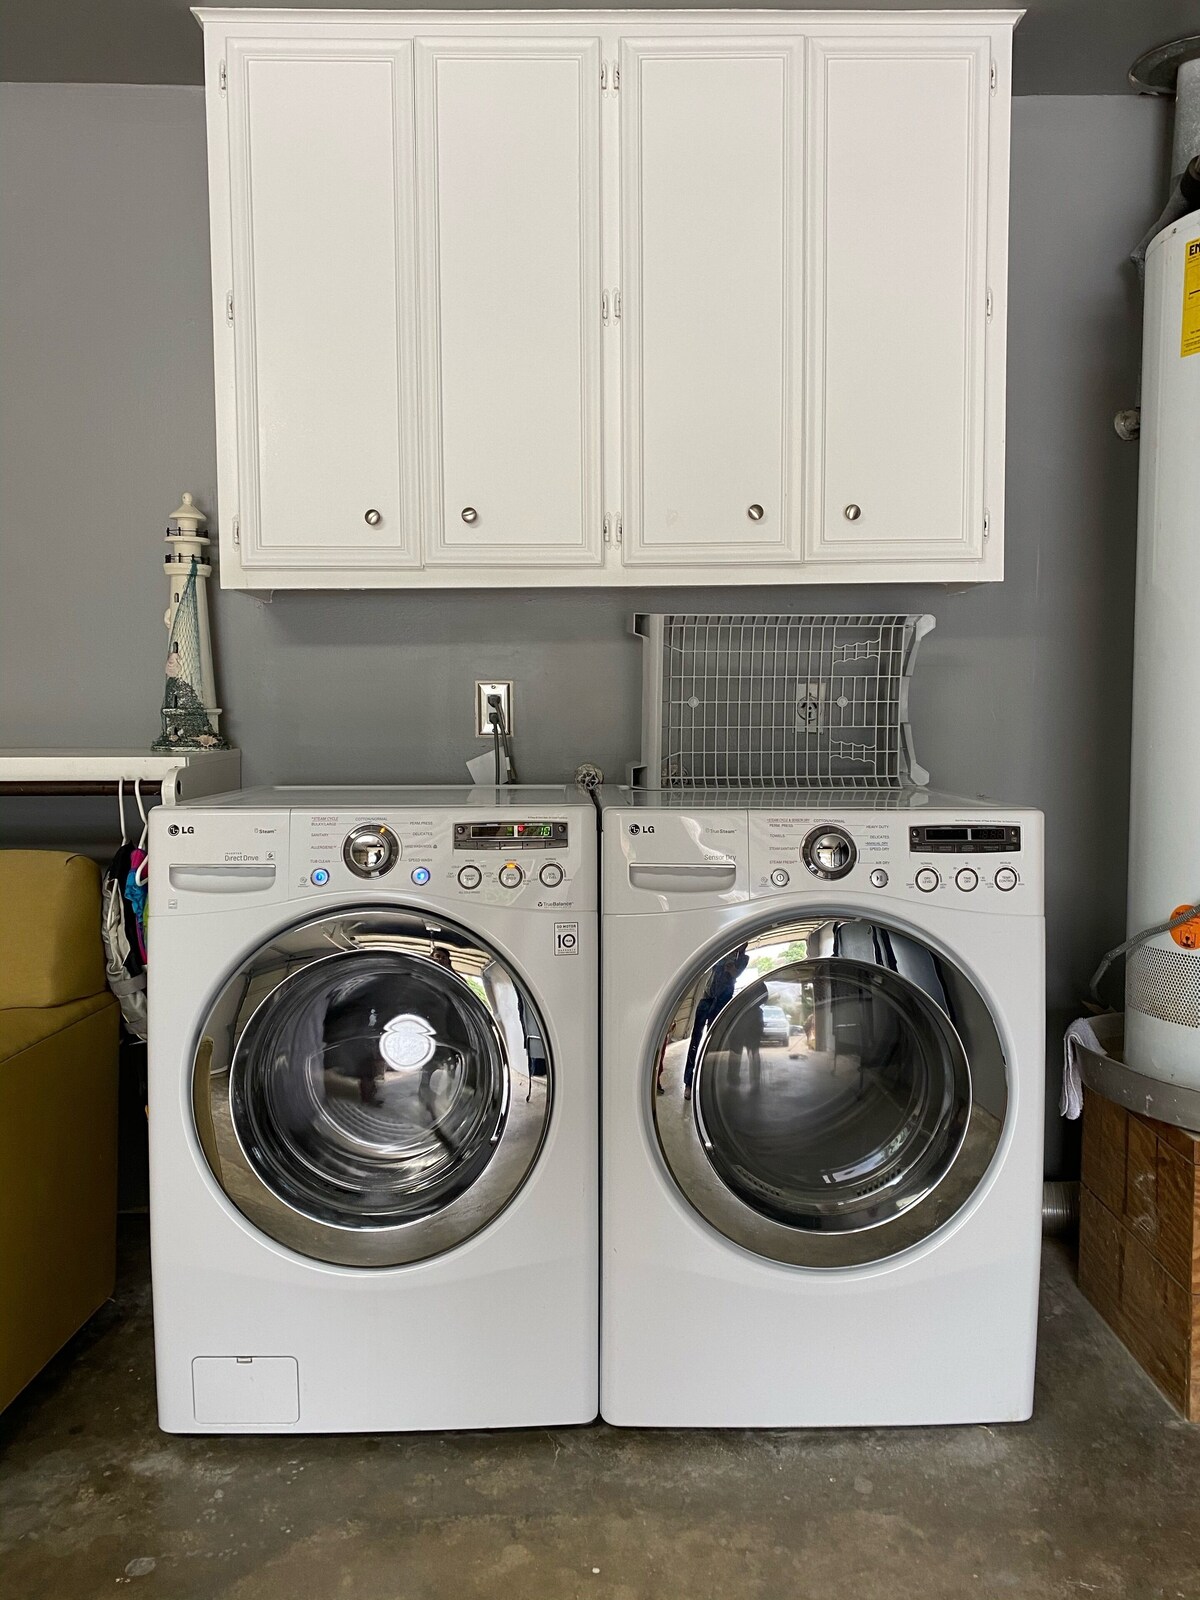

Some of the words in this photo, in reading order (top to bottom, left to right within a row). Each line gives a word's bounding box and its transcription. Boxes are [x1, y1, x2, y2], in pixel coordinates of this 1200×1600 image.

[181, 826, 195, 834] LG
[642, 825, 655, 834] LG
[557, 934, 576, 948] 10
